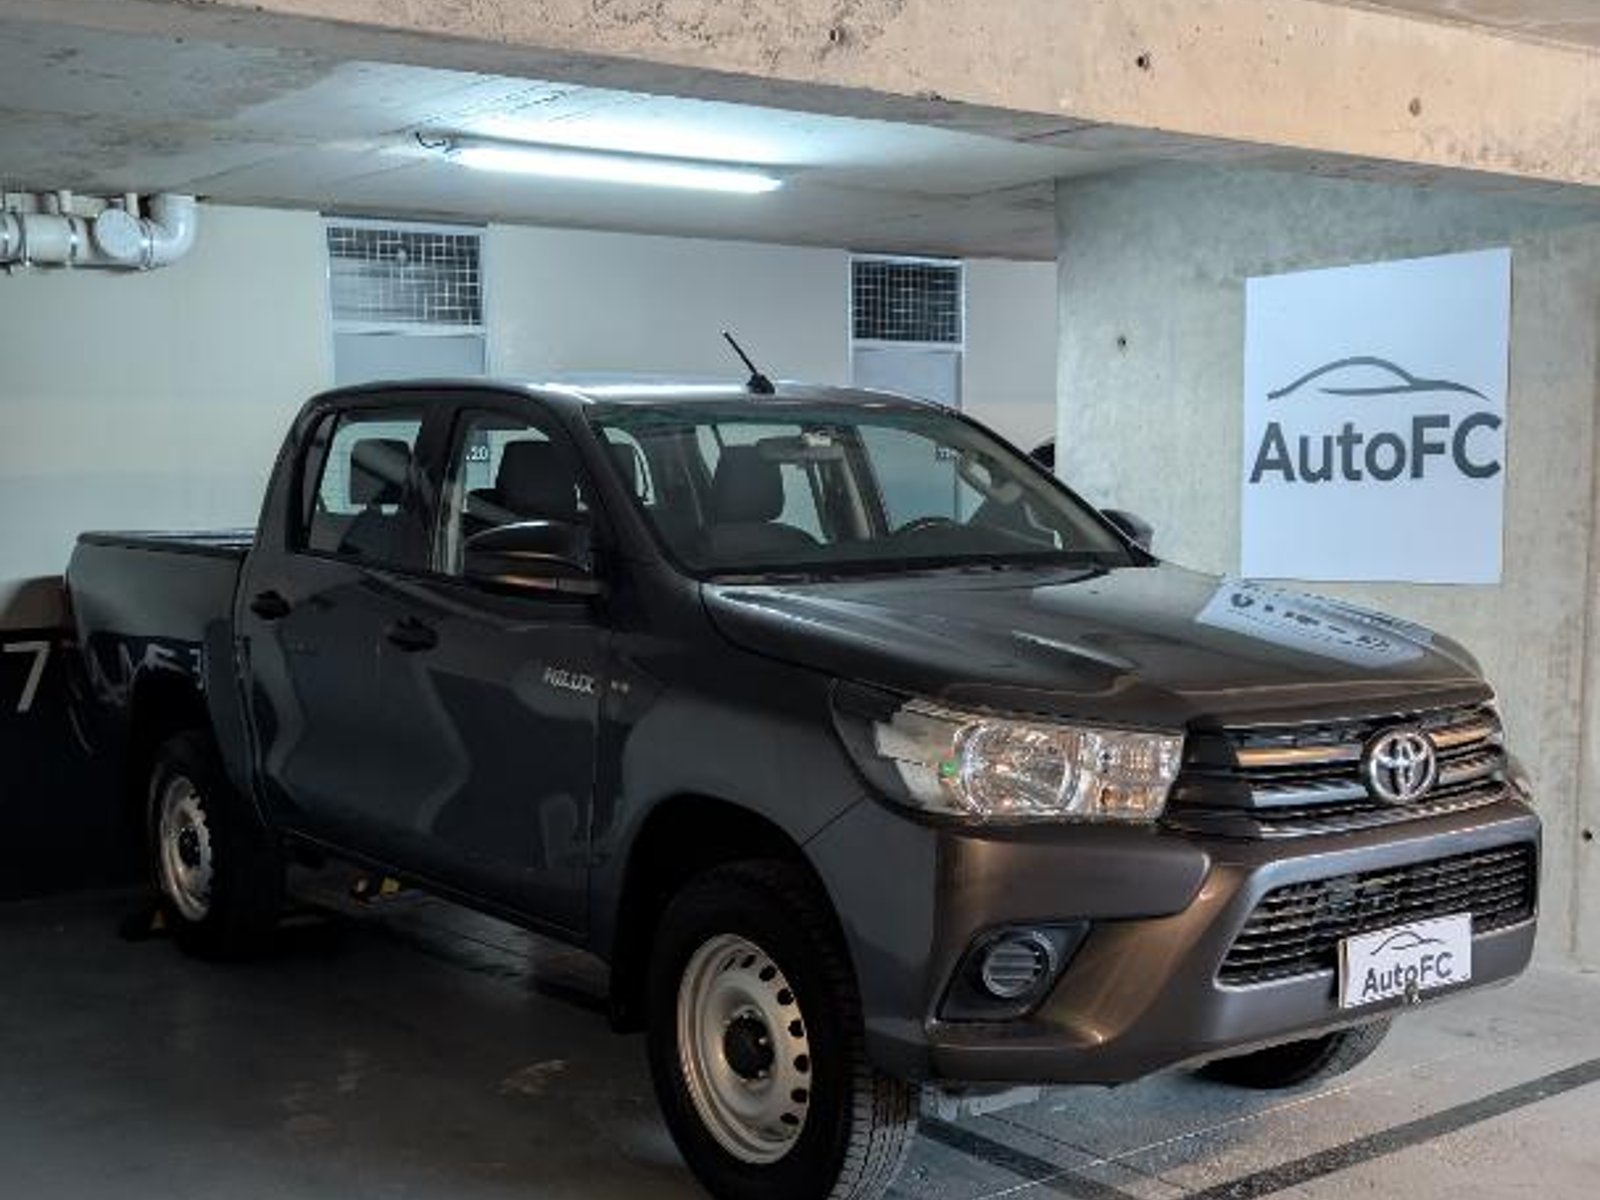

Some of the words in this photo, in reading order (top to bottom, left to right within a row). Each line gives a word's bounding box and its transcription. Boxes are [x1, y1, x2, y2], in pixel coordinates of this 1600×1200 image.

[1249, 412, 1502, 484] AutoFC
[3, 641, 50, 713] 7
[1362, 951, 1453, 998] AutoFC
